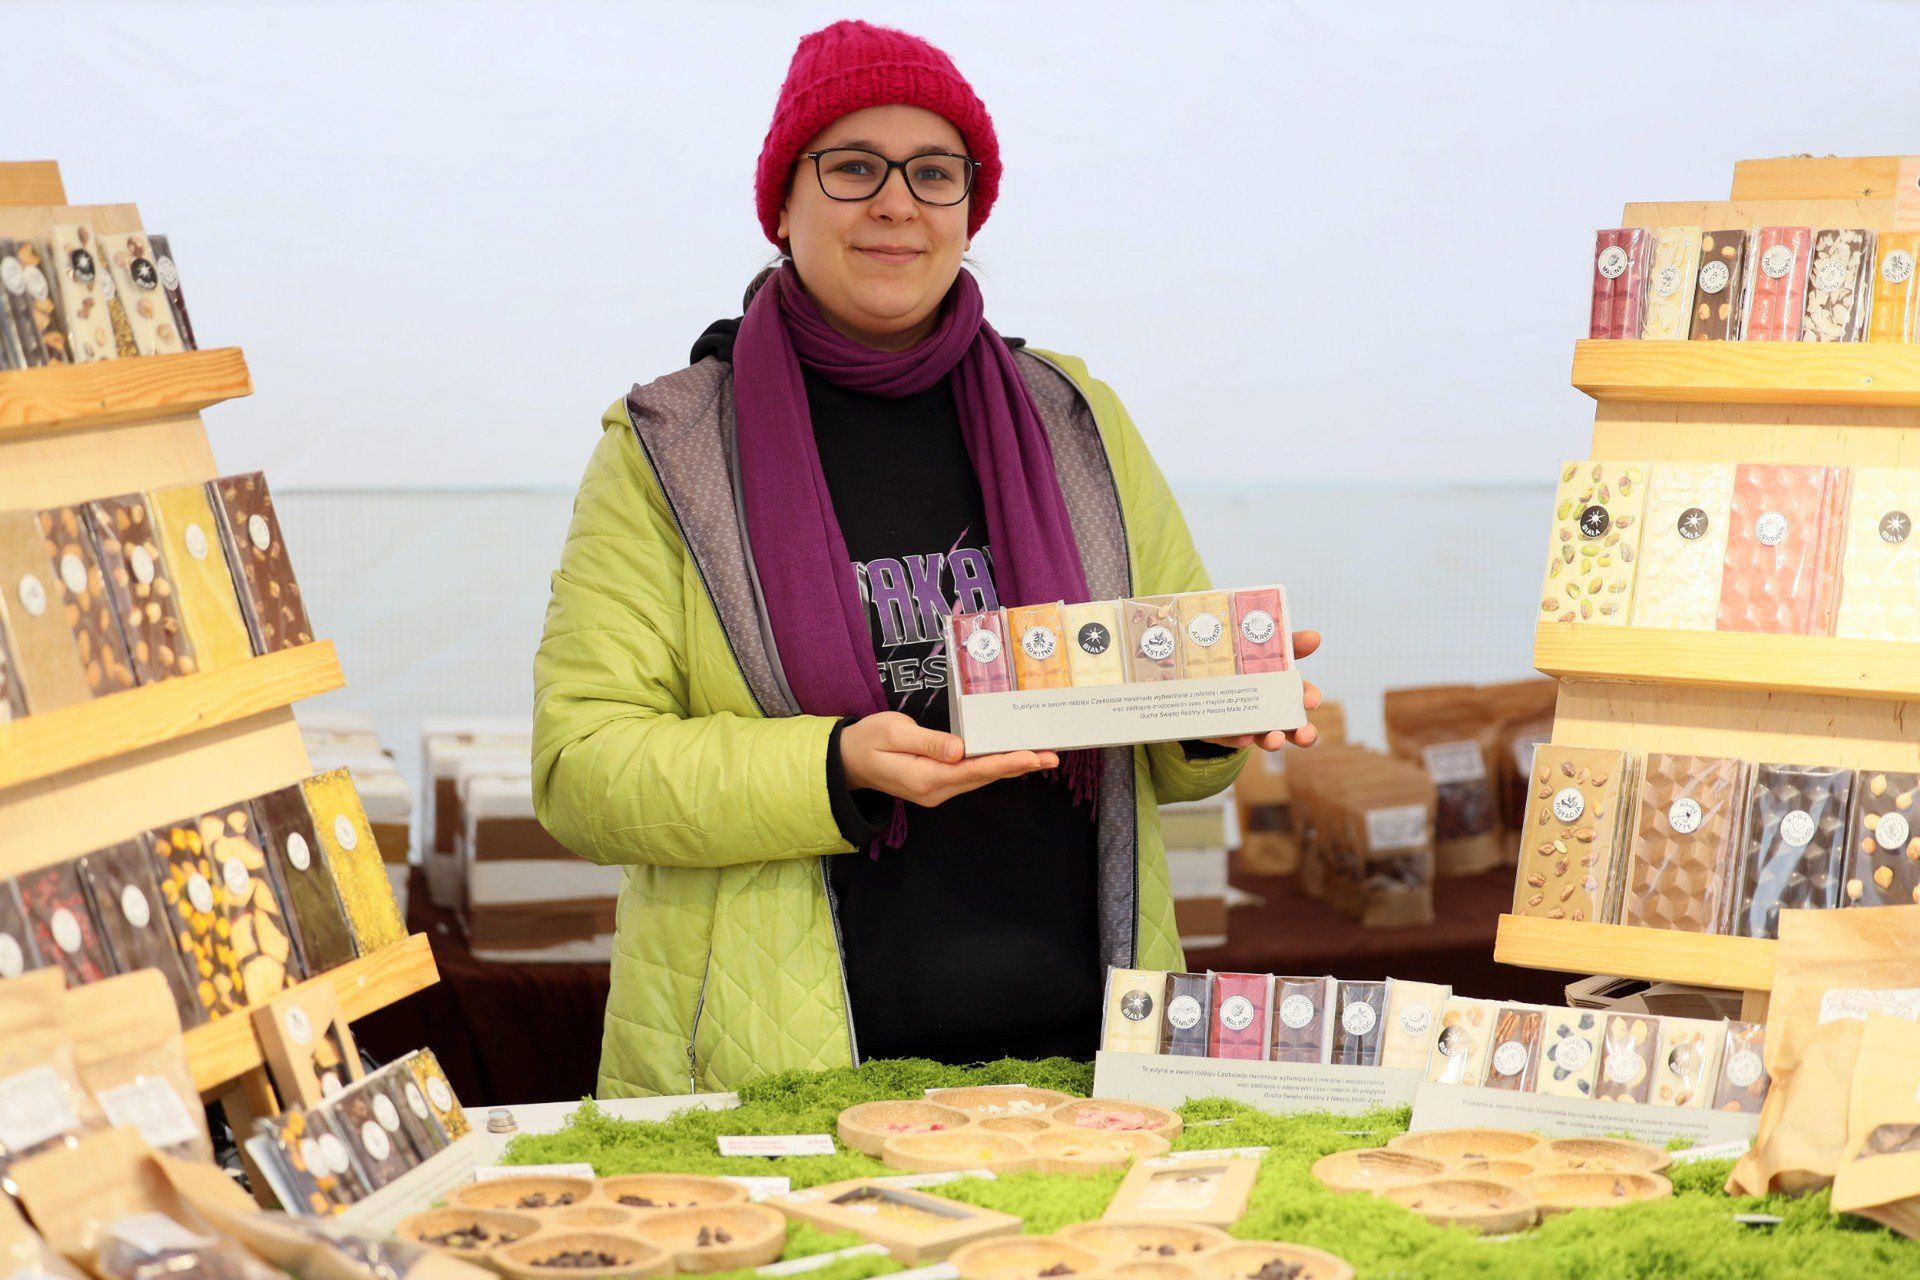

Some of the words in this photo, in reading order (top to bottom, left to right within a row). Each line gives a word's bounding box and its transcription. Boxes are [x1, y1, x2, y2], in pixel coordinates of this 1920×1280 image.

[1602, 264, 1623, 275] MALINA
[1582, 524, 1601, 536] BIAŁA
[1680, 527, 1701, 539] BIAŁA
[1881, 531, 1904, 543] BIAŁA
[850, 547, 1001, 648] AKA
[1191, 623, 1220, 643] AJURWEDA
[1244, 622, 1273, 640] TRUSKAWKA
[973, 648, 996, 660] MALINA
[1025, 641, 1054, 658] ROKITNIK
[1083, 643, 1105, 654] BIAŁA
[1144, 639, 1173, 658] PISTACJA
[877, 655, 949, 693] ES
[1556, 803, 1581, 818] PISTACJA
[1122, 1009, 1144, 1020] BIAŁA
[1226, 1016, 1250, 1027] MALINA
[1345, 1020, 1373, 1032] CLASSIC
